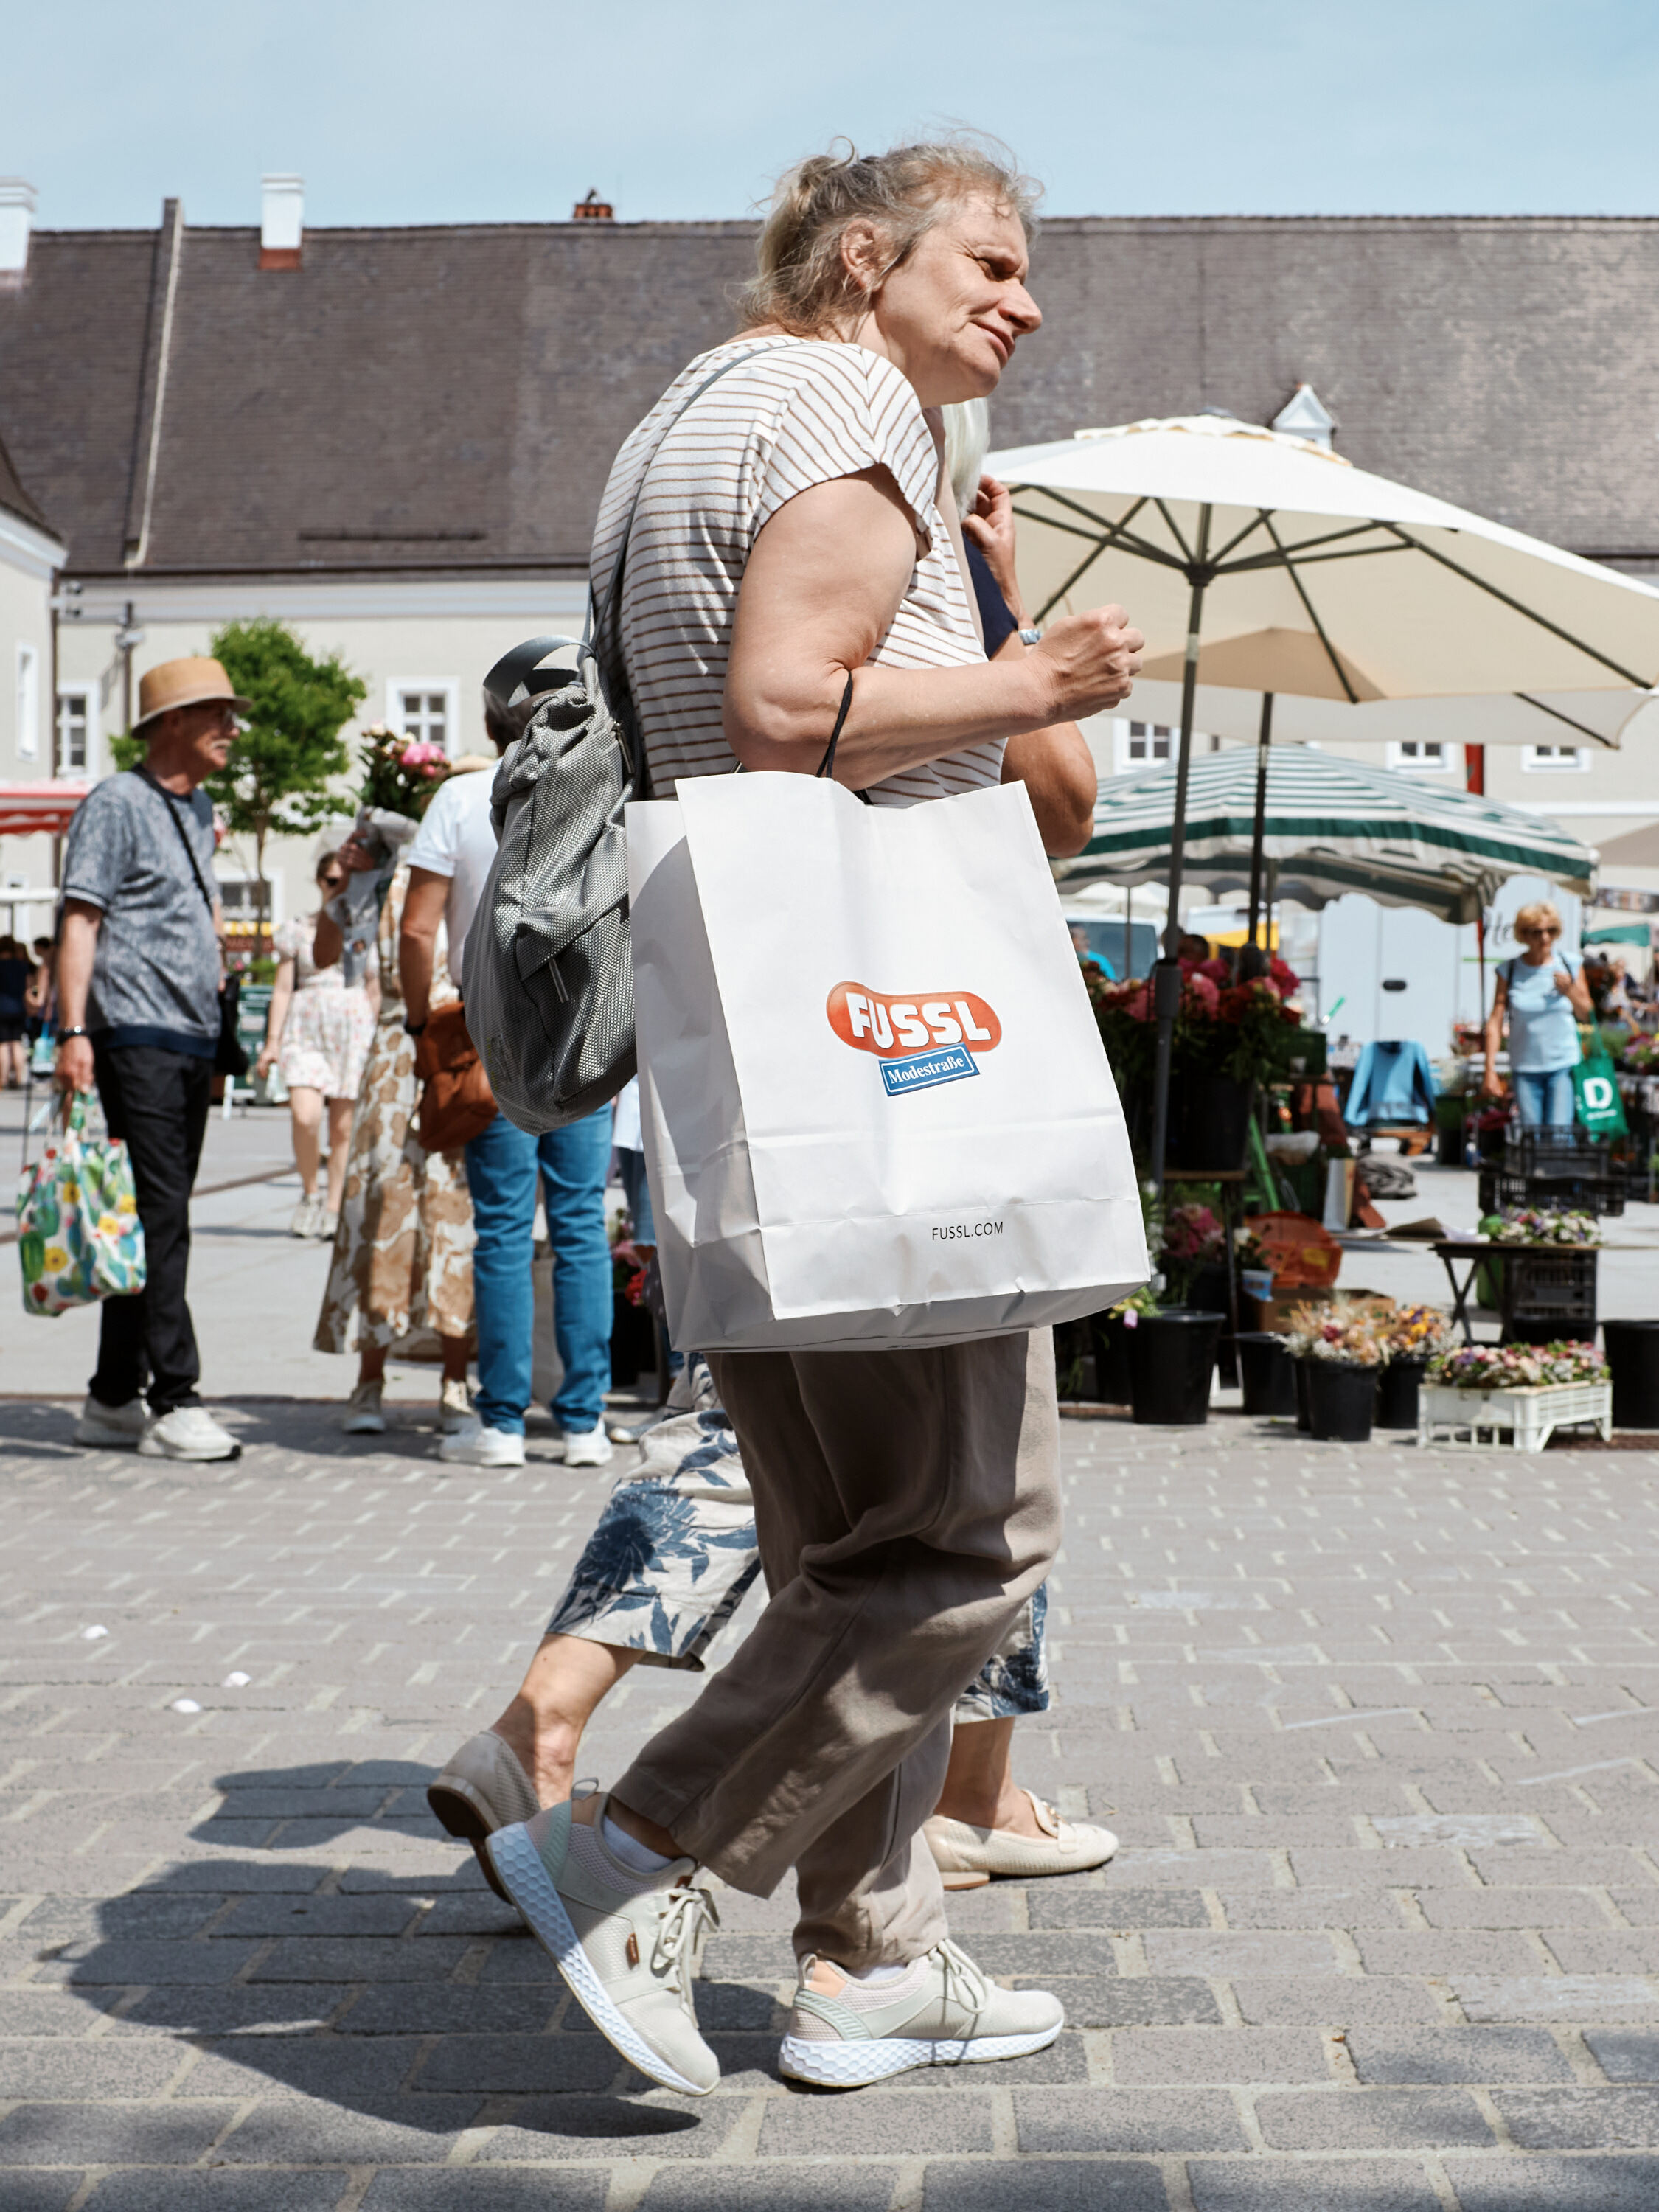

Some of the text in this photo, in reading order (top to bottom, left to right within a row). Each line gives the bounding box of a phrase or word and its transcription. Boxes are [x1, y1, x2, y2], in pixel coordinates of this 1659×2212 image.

[846, 992, 992, 1048] FUSSL
[887, 1056, 964, 1084] Modestraße
[1583, 1077, 1613, 1109] D
[932, 1221, 1003, 1240] FUSSL.COM
